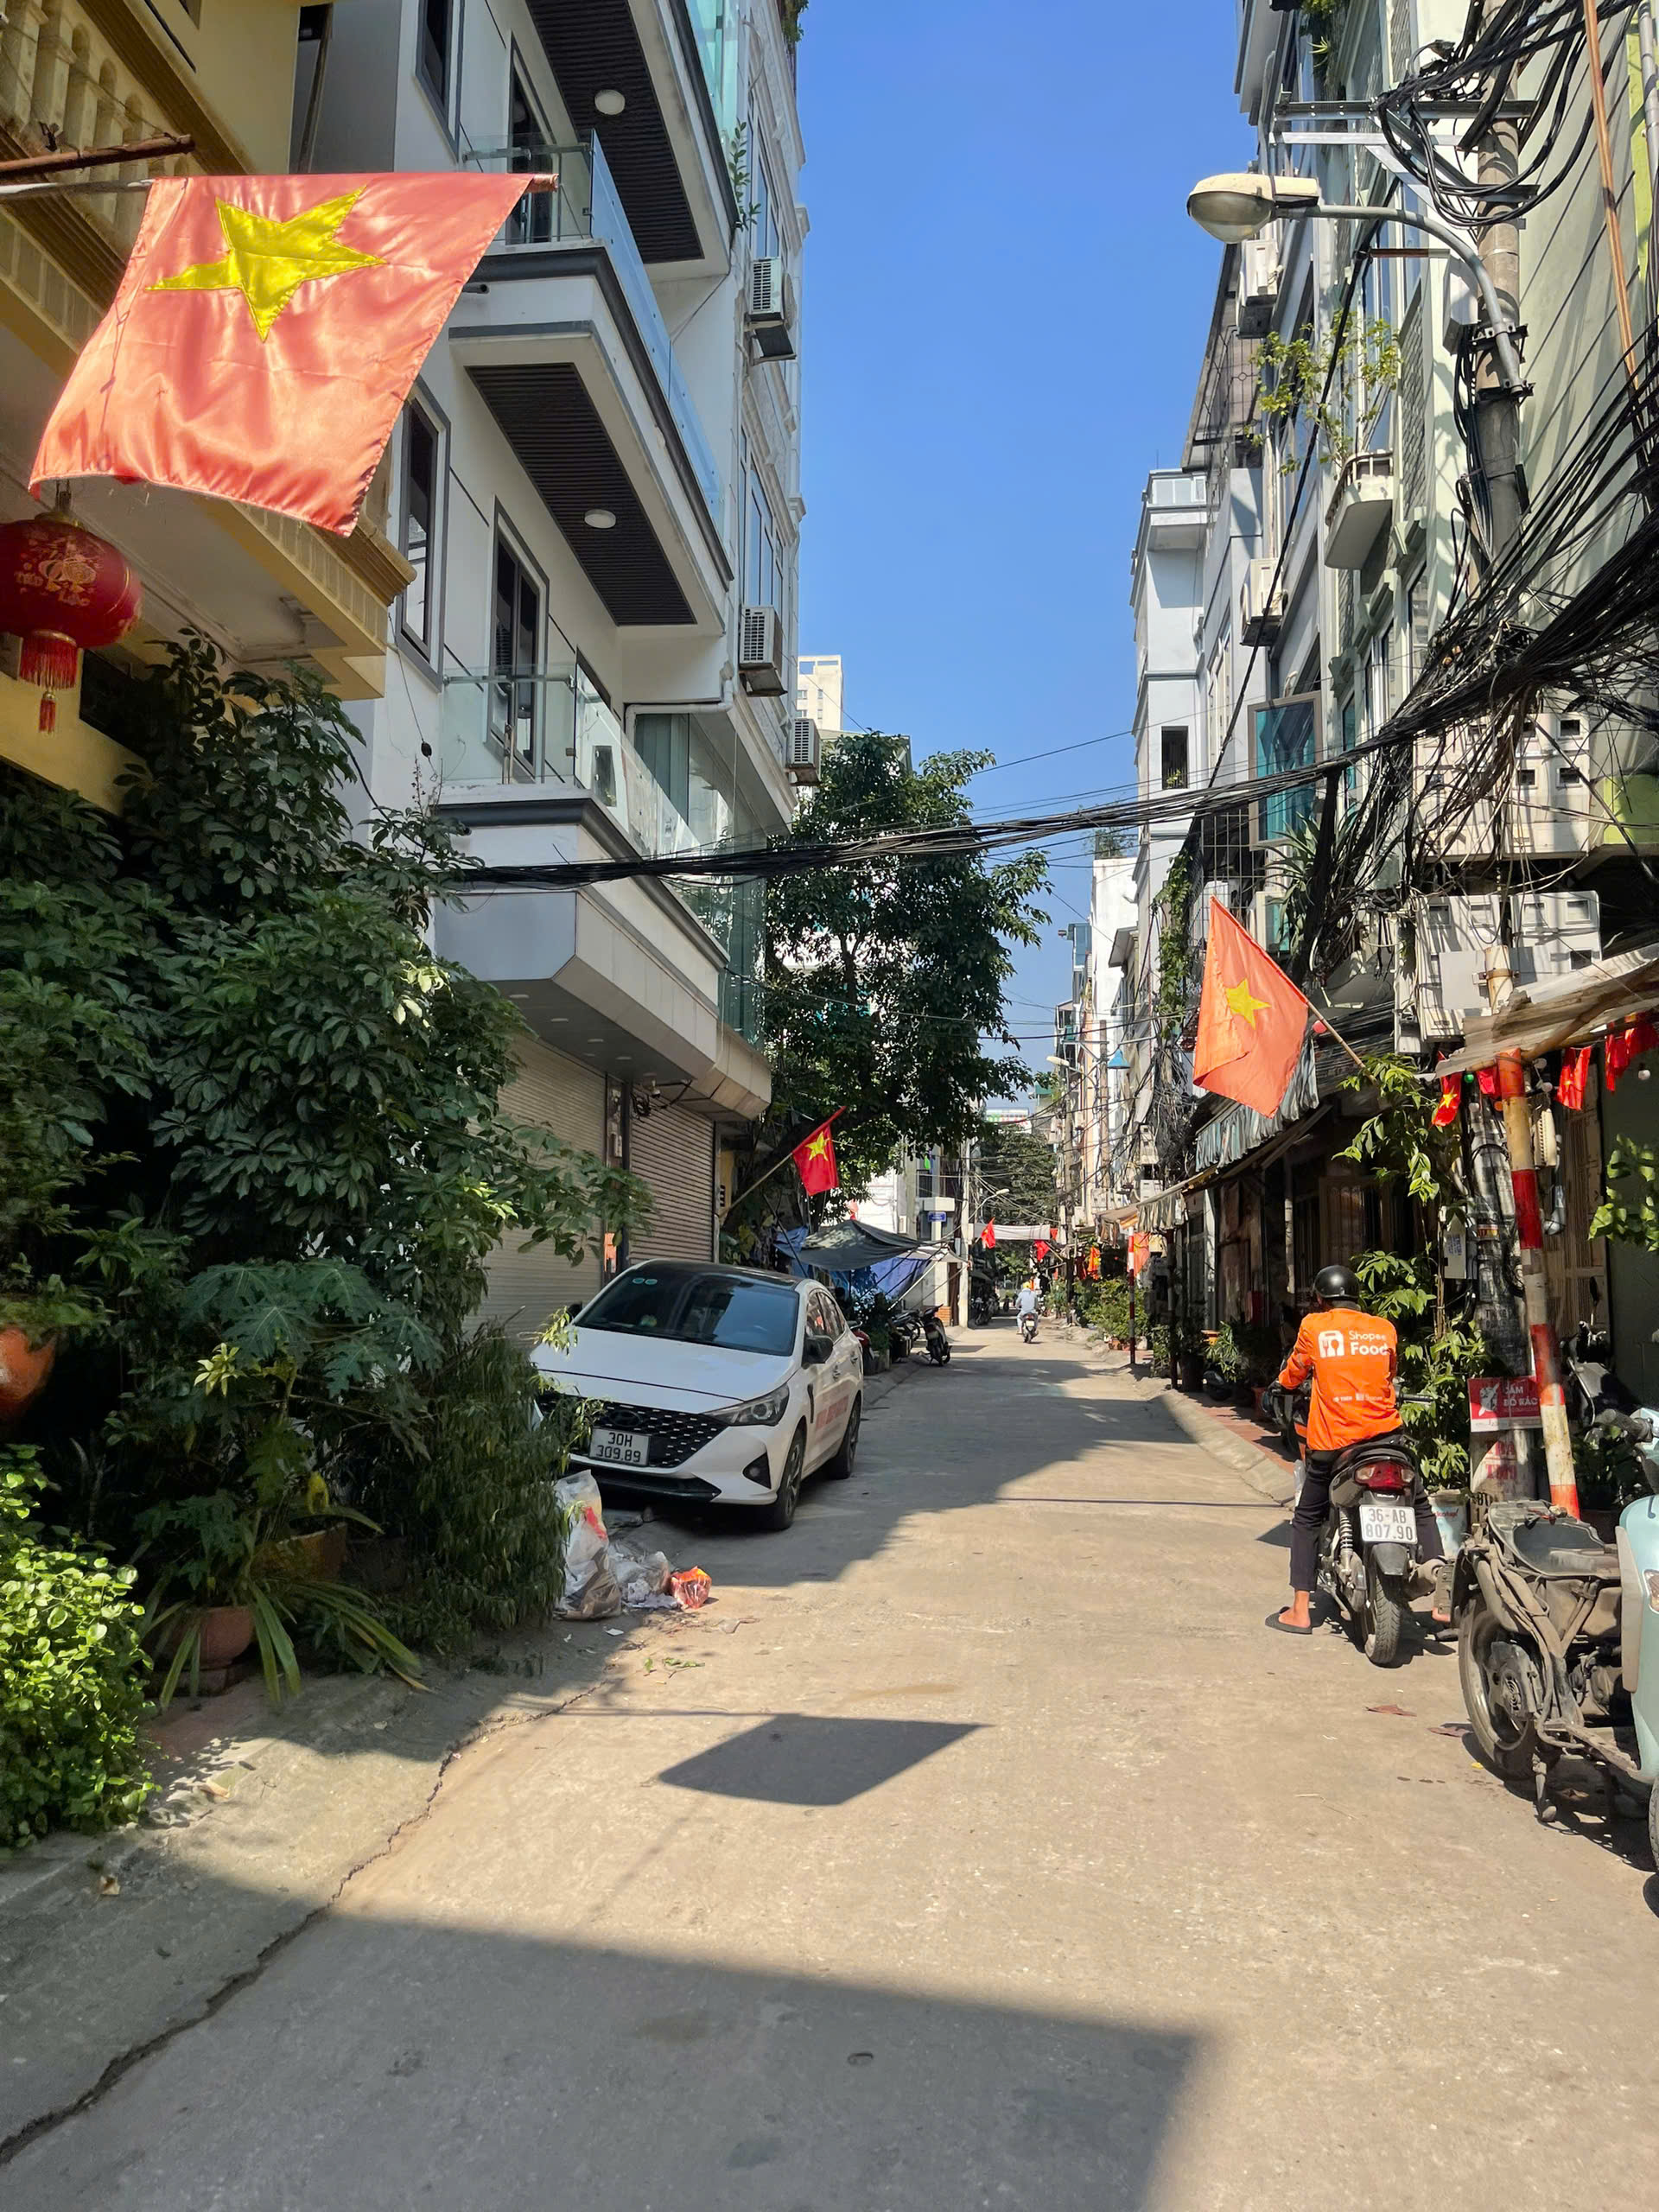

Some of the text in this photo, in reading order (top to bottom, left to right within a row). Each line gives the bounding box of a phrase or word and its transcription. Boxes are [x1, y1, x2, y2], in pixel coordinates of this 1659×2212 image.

[1348, 1330, 1386, 1342] Shopee
[1351, 1341, 1389, 1356] Food
[608, 1432, 632, 1447] 30H
[596, 1445, 641, 1463] 309.89
[1368, 1508, 1407, 1524] 36-AB
[1365, 1524, 1414, 1541] 807.90
